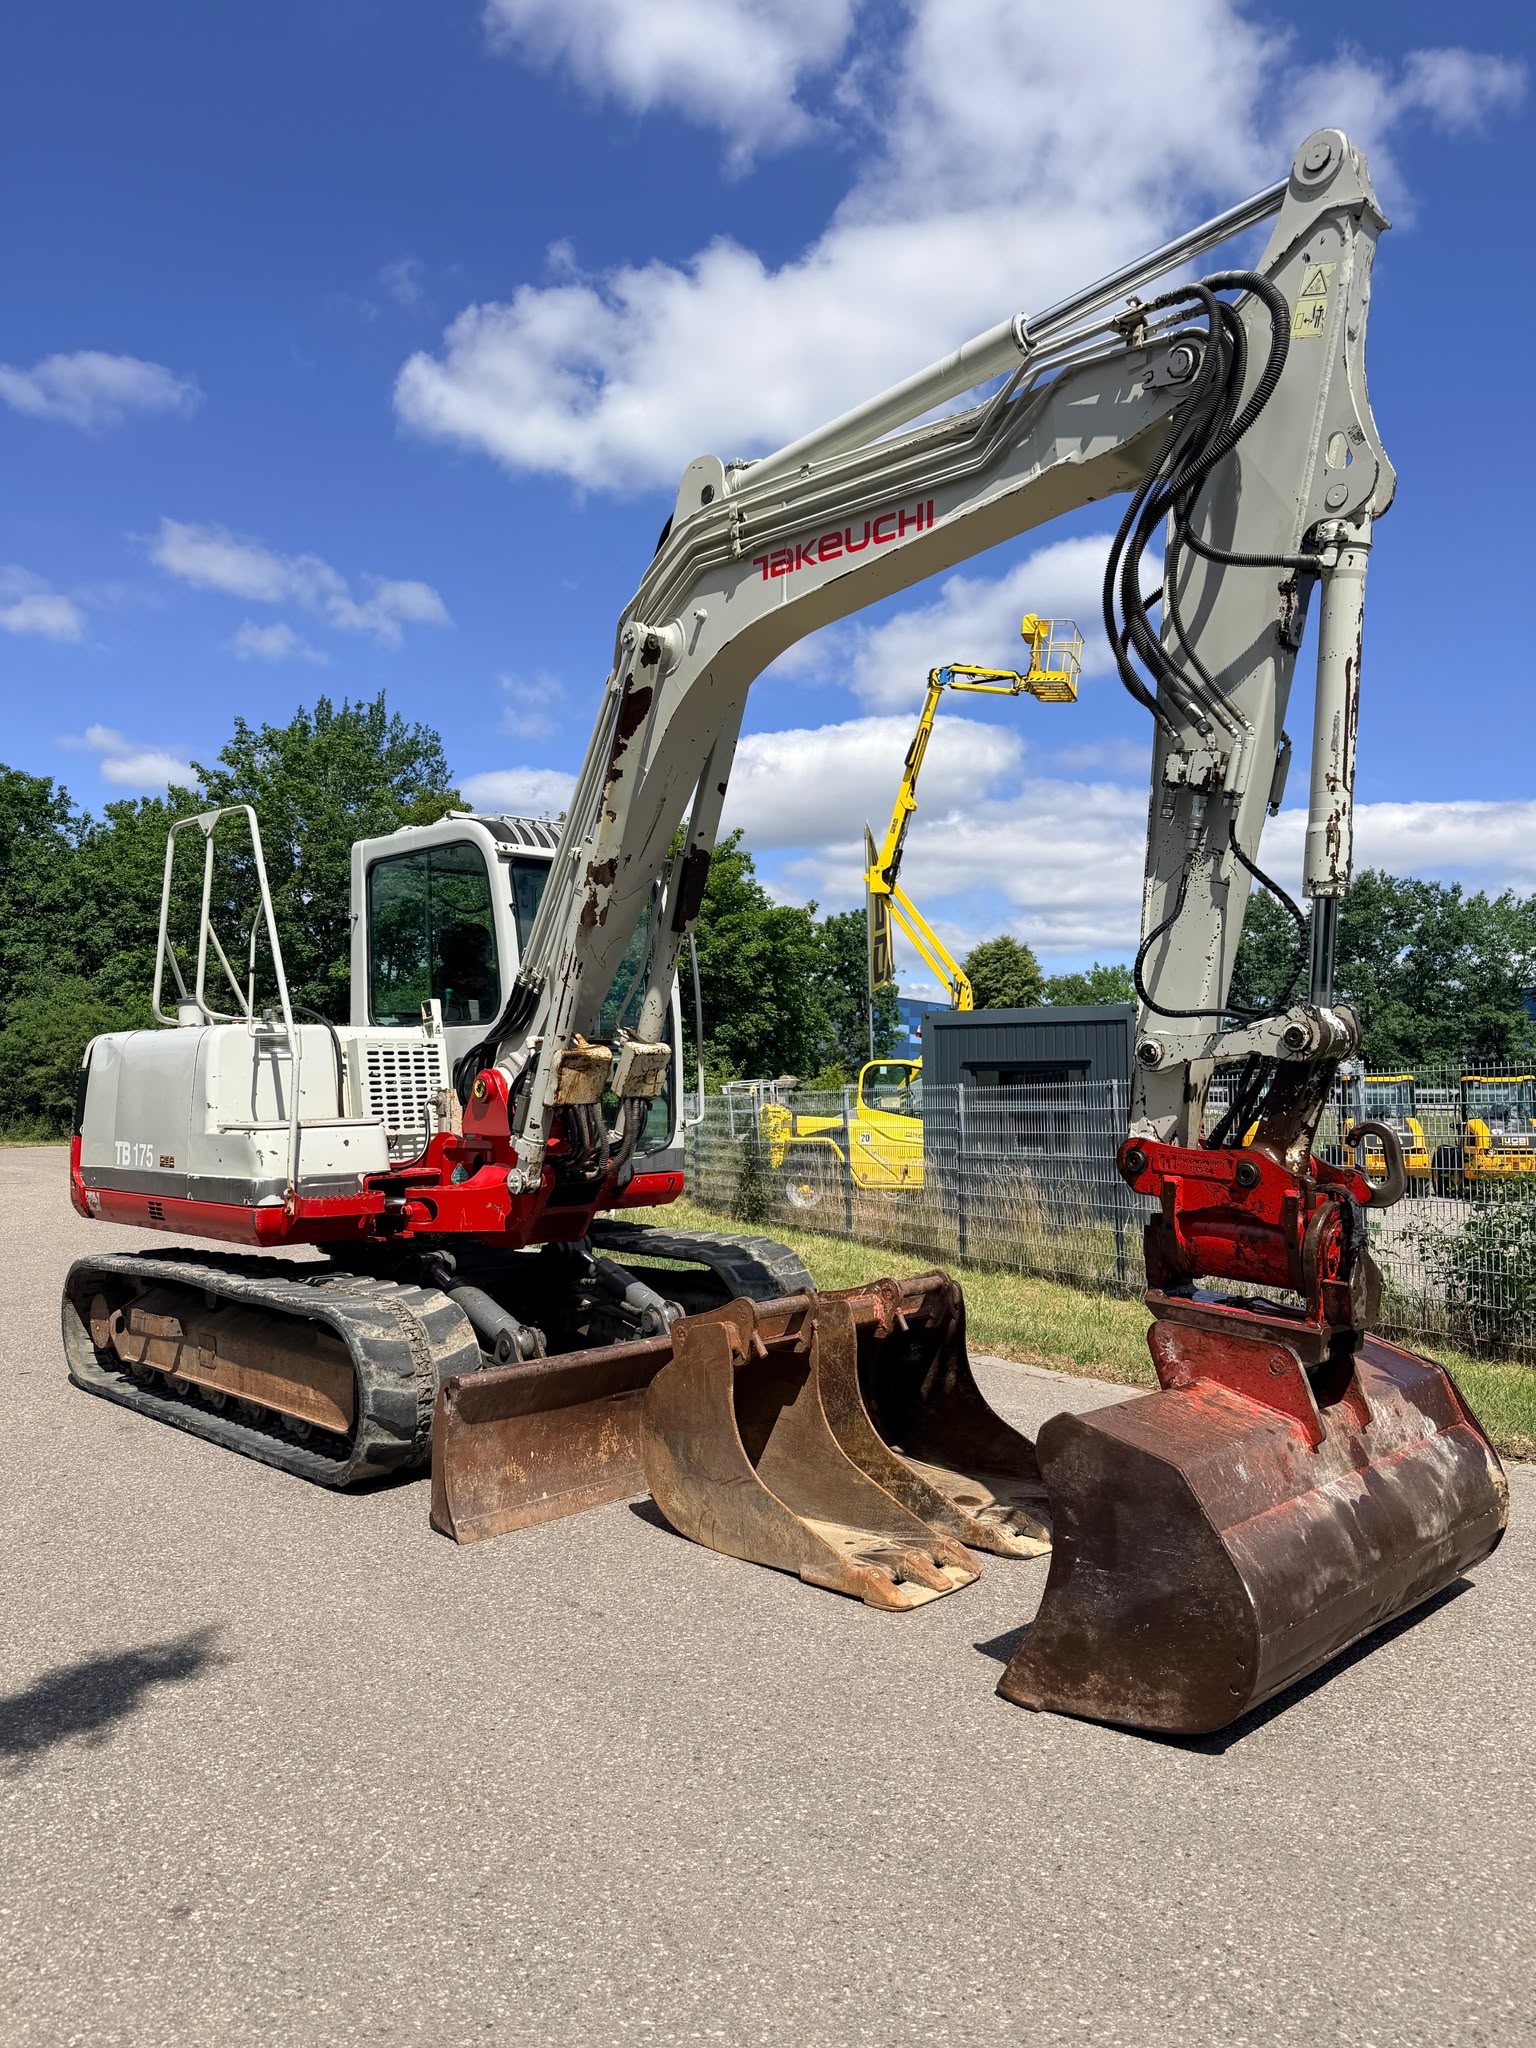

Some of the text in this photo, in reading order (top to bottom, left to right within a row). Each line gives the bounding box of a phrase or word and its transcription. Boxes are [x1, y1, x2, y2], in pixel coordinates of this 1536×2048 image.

[753, 500, 934, 581] TAKEUCHI
[861, 1134, 870, 1142] 20
[115, 1141, 153, 1167] TB 175
[667, 1177, 676, 1194] 7
